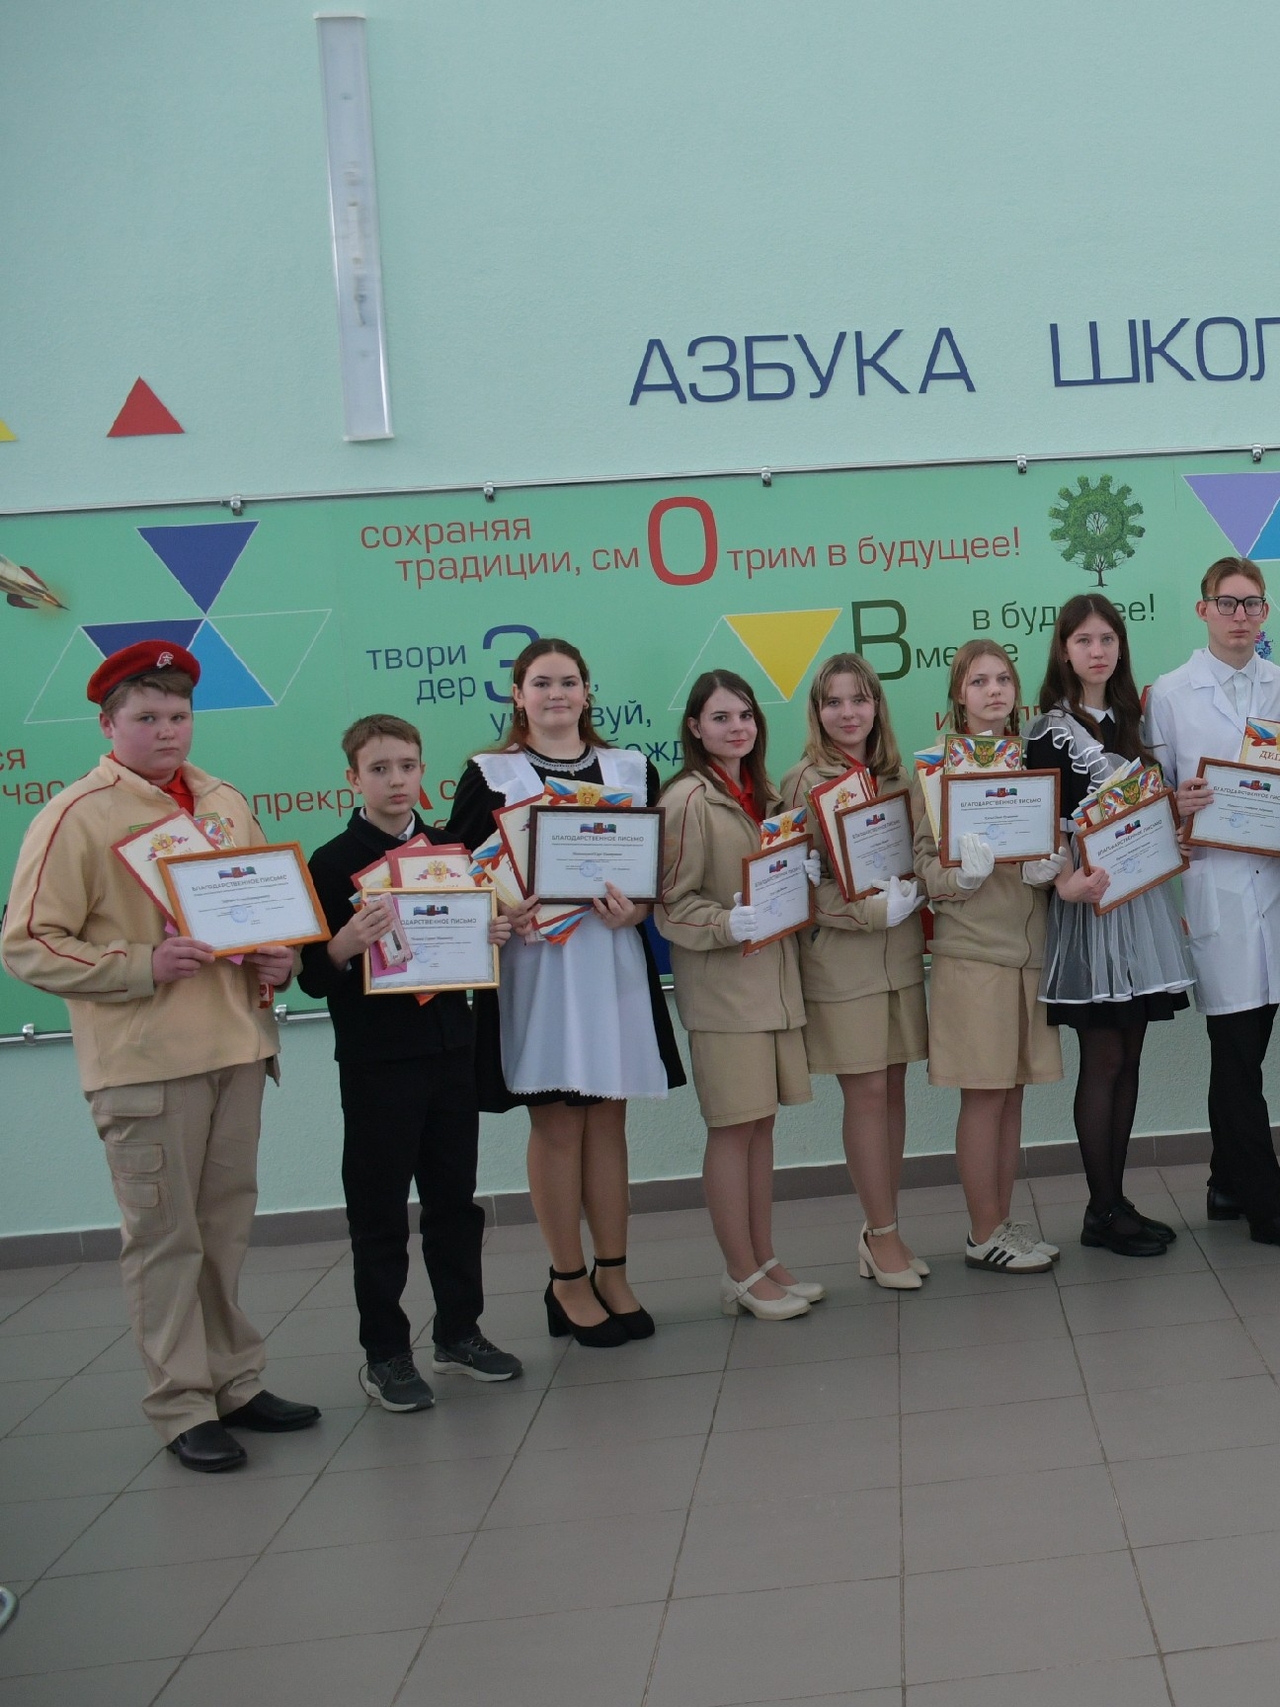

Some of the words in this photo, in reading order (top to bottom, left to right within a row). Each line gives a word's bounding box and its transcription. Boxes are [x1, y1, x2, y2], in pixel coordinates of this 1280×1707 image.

[629, 326, 976, 405] АЗБУКА
[360, 518, 532, 554] сохраняя
[395, 551, 581, 589] традиции,
[828, 541, 847, 566] в
[858, 526, 1022, 570] будущее!
[972, 609, 991, 631] в
[1001, 593, 1156, 636] будее!
[366, 644, 467, 674] твори
[960, 800, 1018, 808] БЛАГОДАРСТВЕННОЕ
